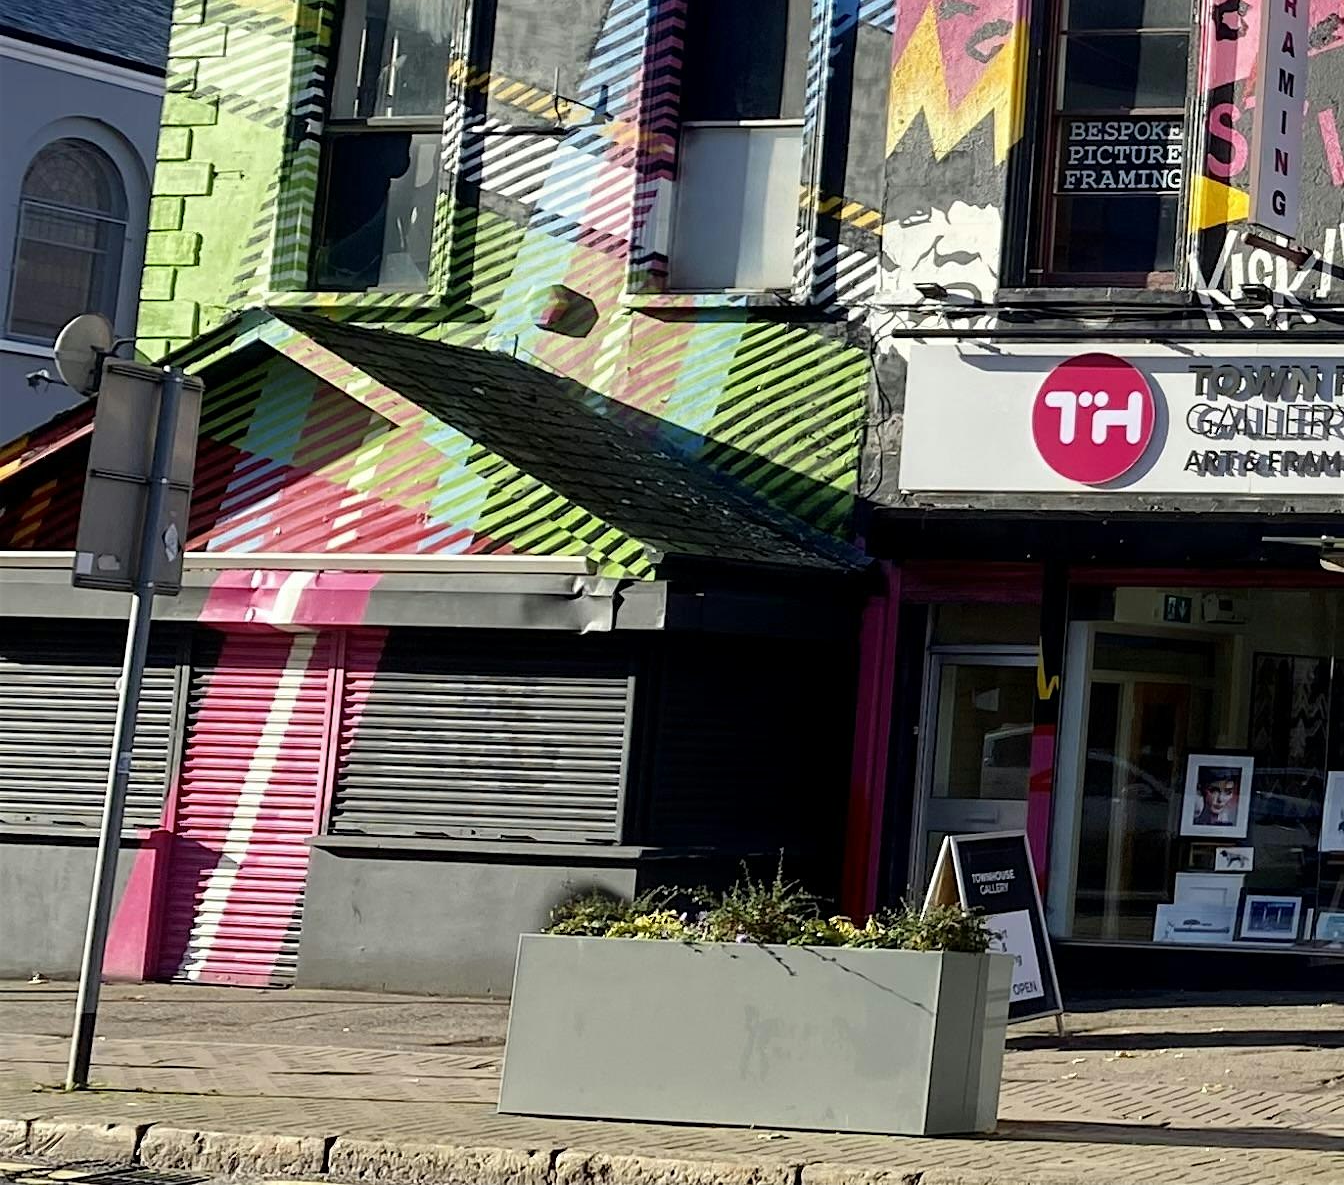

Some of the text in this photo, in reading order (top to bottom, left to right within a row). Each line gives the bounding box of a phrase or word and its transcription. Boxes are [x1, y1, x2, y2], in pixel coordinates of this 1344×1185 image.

[1069, 121, 1183, 141] BESPOKE
[1067, 145, 1182, 165] PICTURE
[1063, 169, 1182, 189] FRAMING
[1188, 365, 1320, 400] TOWN
[1044, 391, 1142, 445] TH
[1184, 450, 1238, 474] ART
[1244, 449, 1261, 473] &
[979, 882, 1009, 895] GALLERY
[1012, 980, 1038, 995] OPEN
